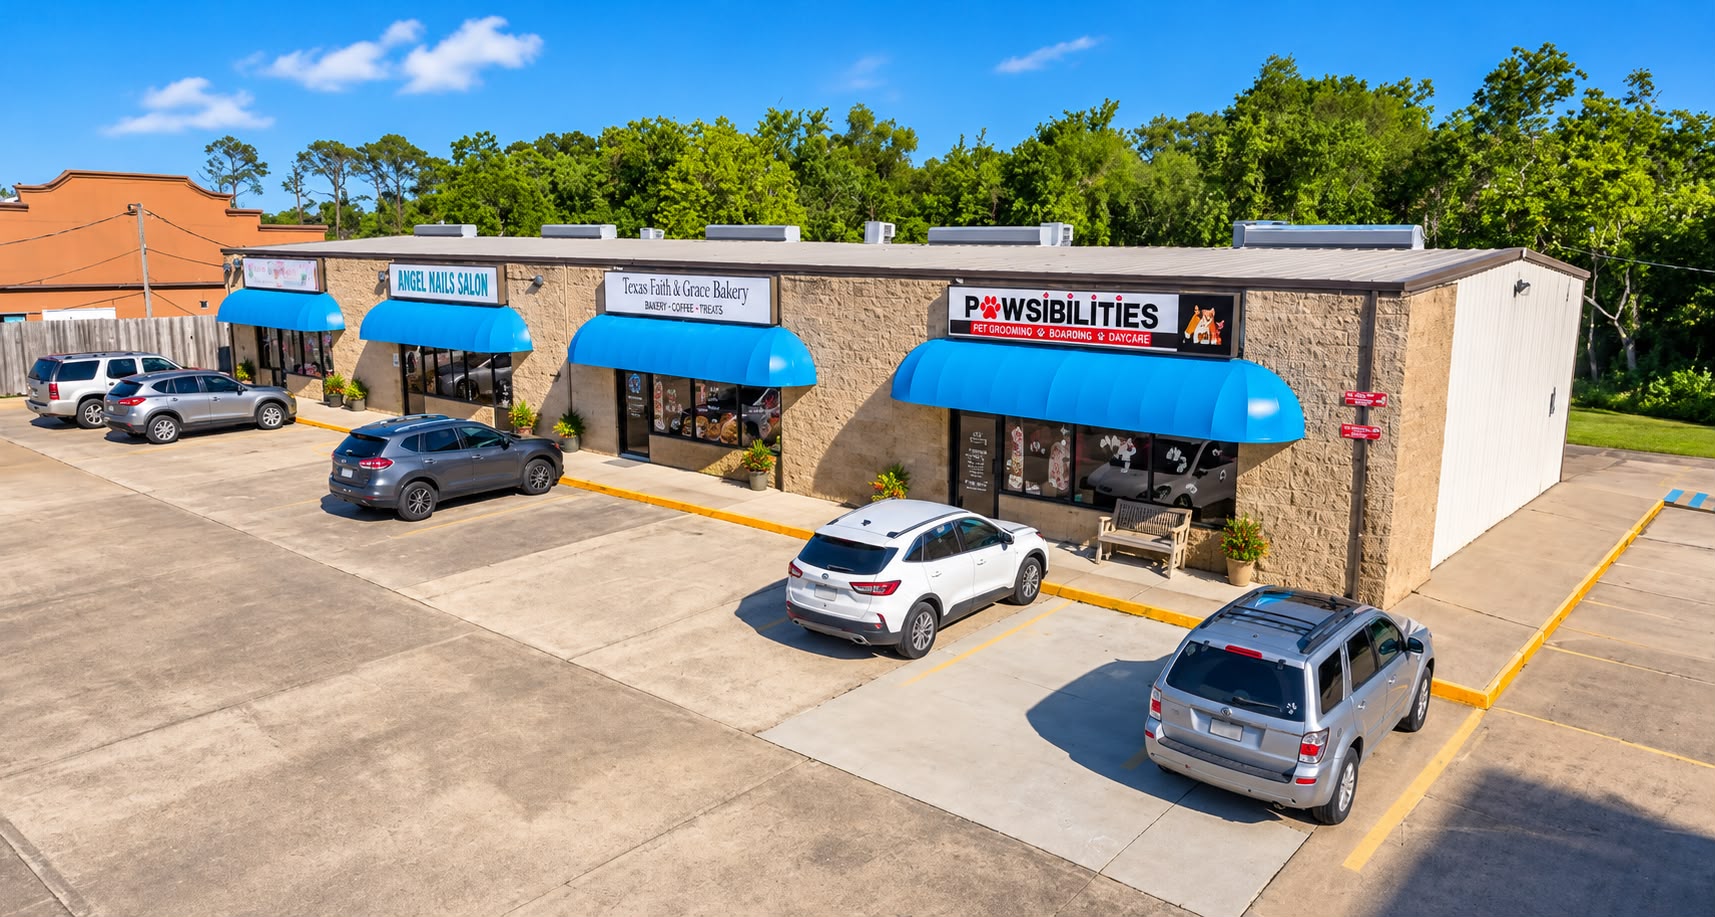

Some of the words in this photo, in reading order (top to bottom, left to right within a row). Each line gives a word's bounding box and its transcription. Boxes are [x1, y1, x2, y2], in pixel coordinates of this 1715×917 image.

[398, 269, 426, 292] ANGEL
[429, 271, 455, 294] NAILS
[458, 272, 488, 296] SALON
[622, 277, 648, 295] Texas
[650, 278, 671, 297] Faith
[673, 280, 680, 296] &
[682, 280, 711, 298] Grace
[713, 280, 749, 306] Bakery
[644, 300, 667, 311] BAKERY
[671, 302, 694, 313] COFFEE
[699, 303, 724, 315] TREATS
[973, 323, 987, 333] PET
[1049, 329, 1092, 341] BOARDING
[1108, 332, 1150, 345] DAYCARE
